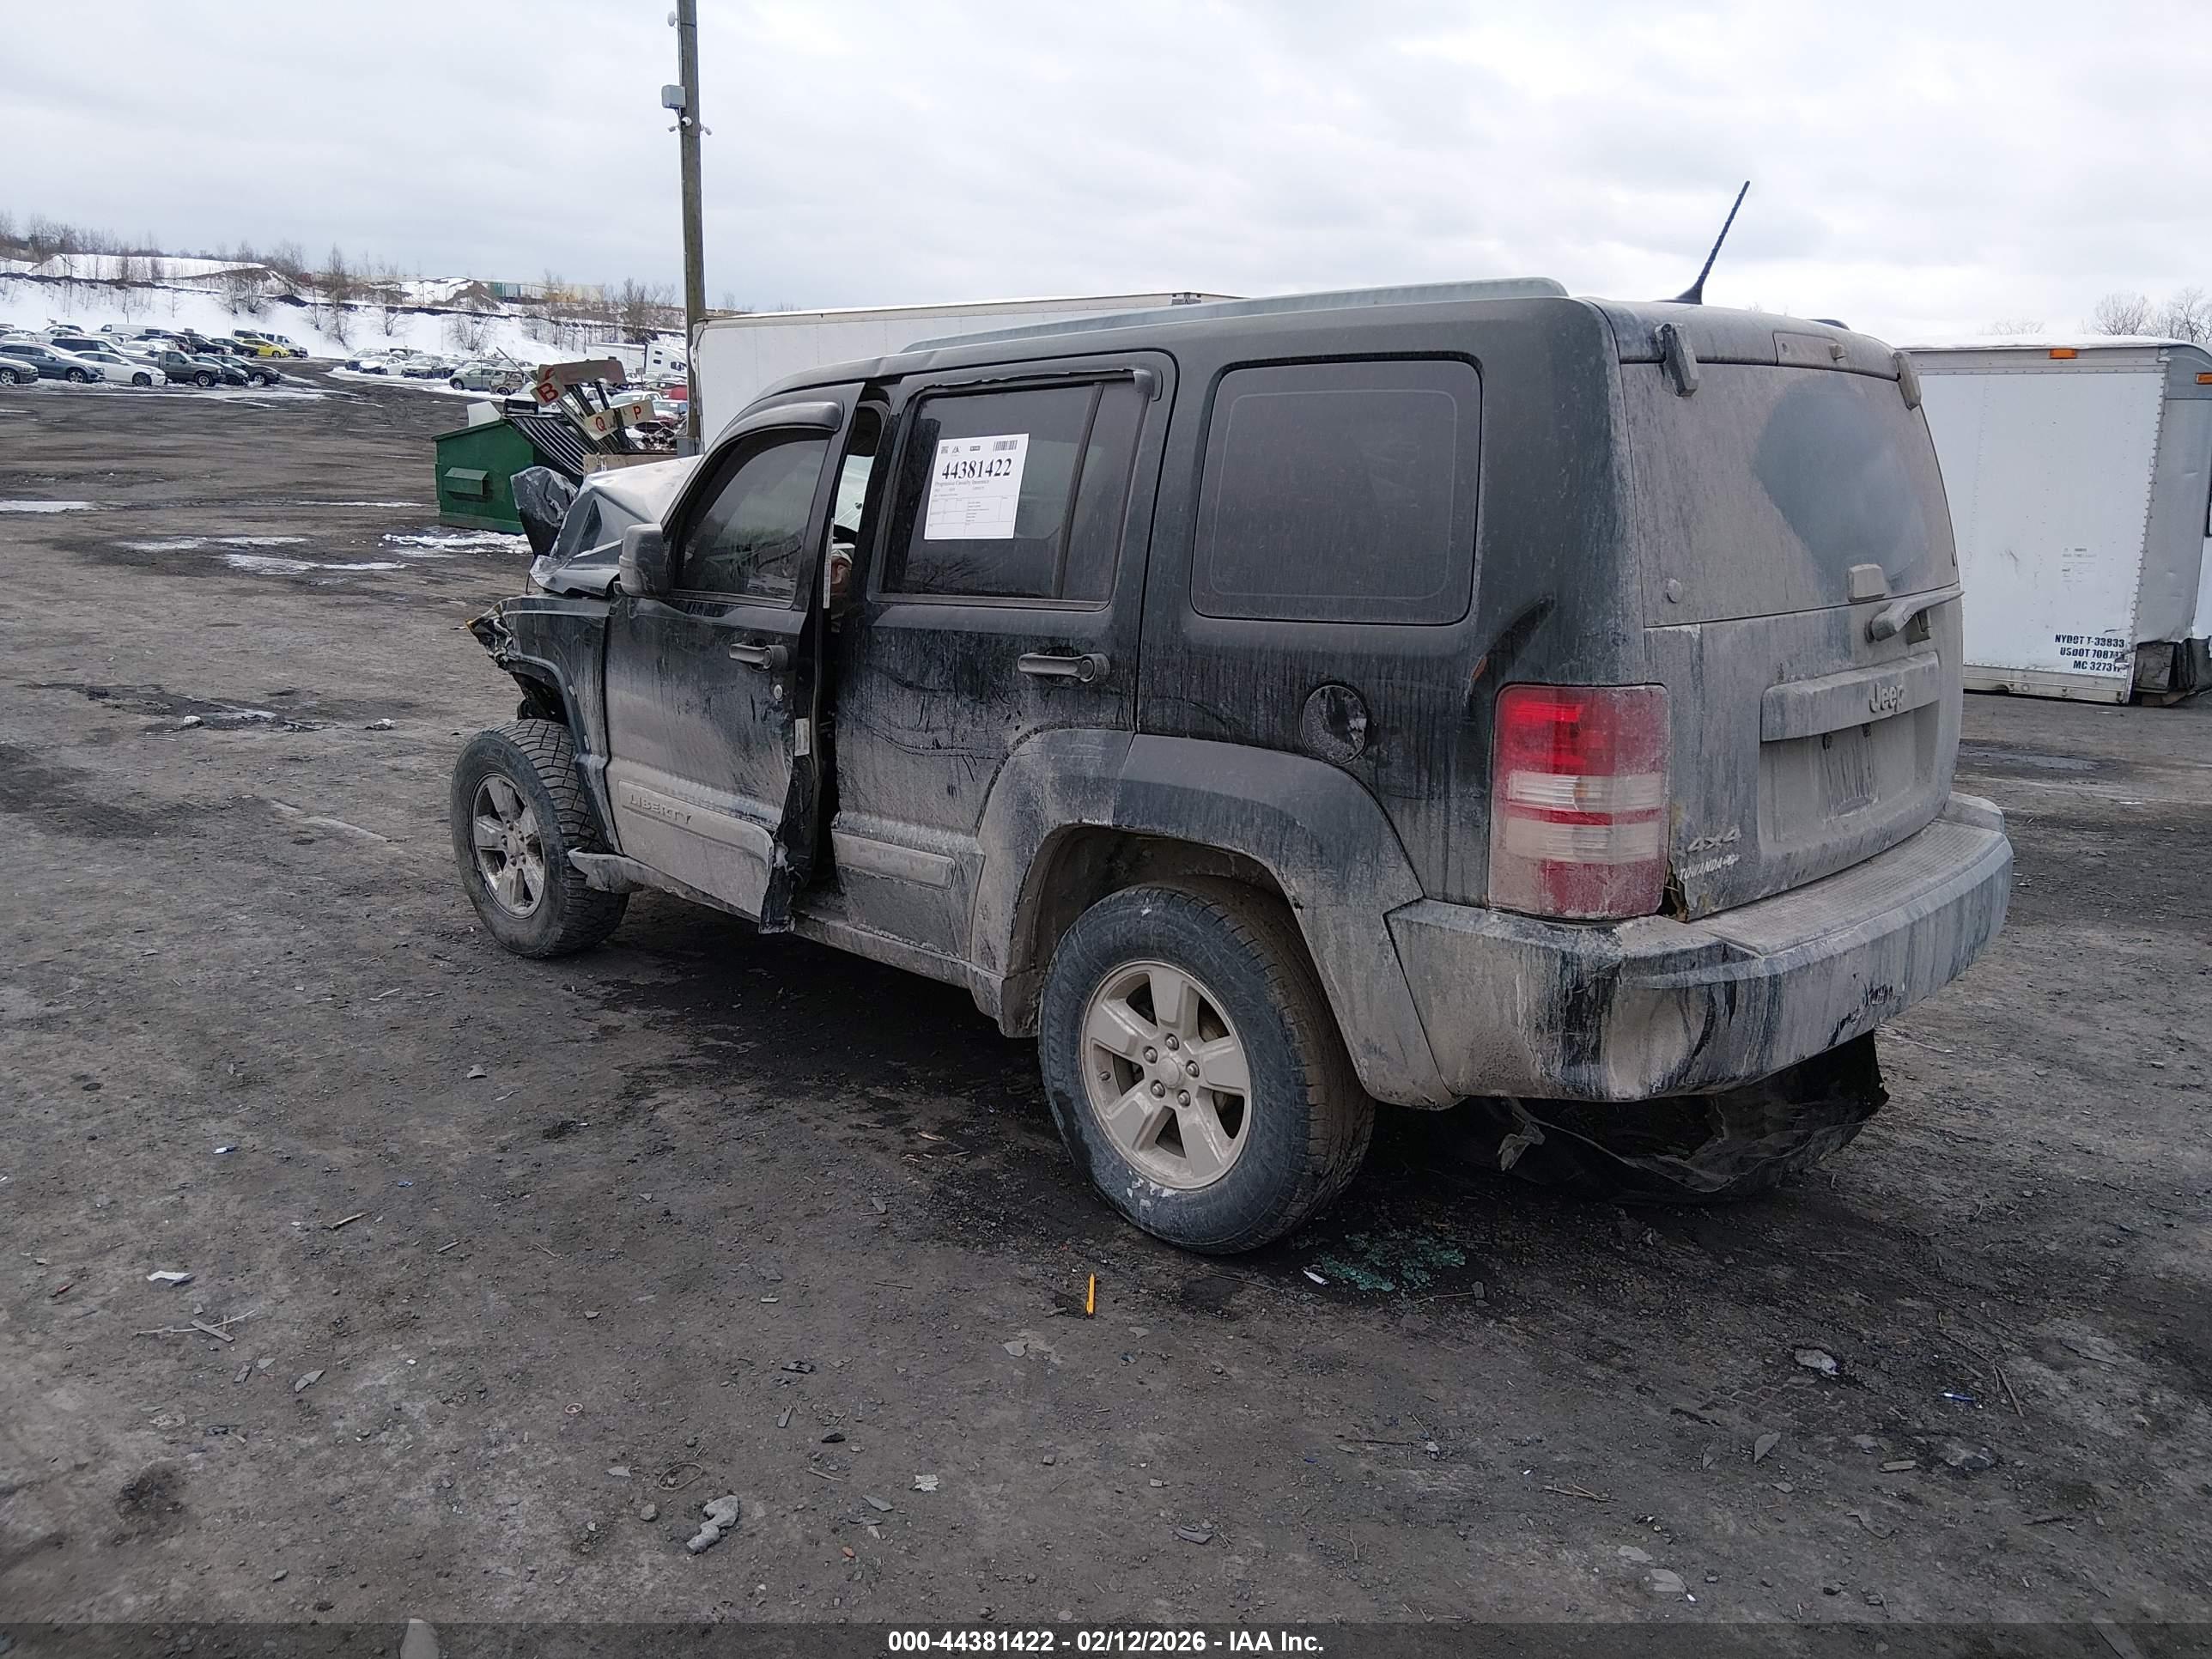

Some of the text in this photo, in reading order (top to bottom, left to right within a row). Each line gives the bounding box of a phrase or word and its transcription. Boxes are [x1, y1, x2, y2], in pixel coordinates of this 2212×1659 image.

[536, 383, 559, 403] B
[633, 405, 641, 420] P
[942, 458, 1012, 480] 44381422
[2055, 634, 2085, 645] NYDOT
[2060, 647, 2091, 658] USDOT
[2073, 660, 2087, 670] MC
[1869, 683, 1905, 714] Jeep
[630, 793, 693, 825] LIBERTY
